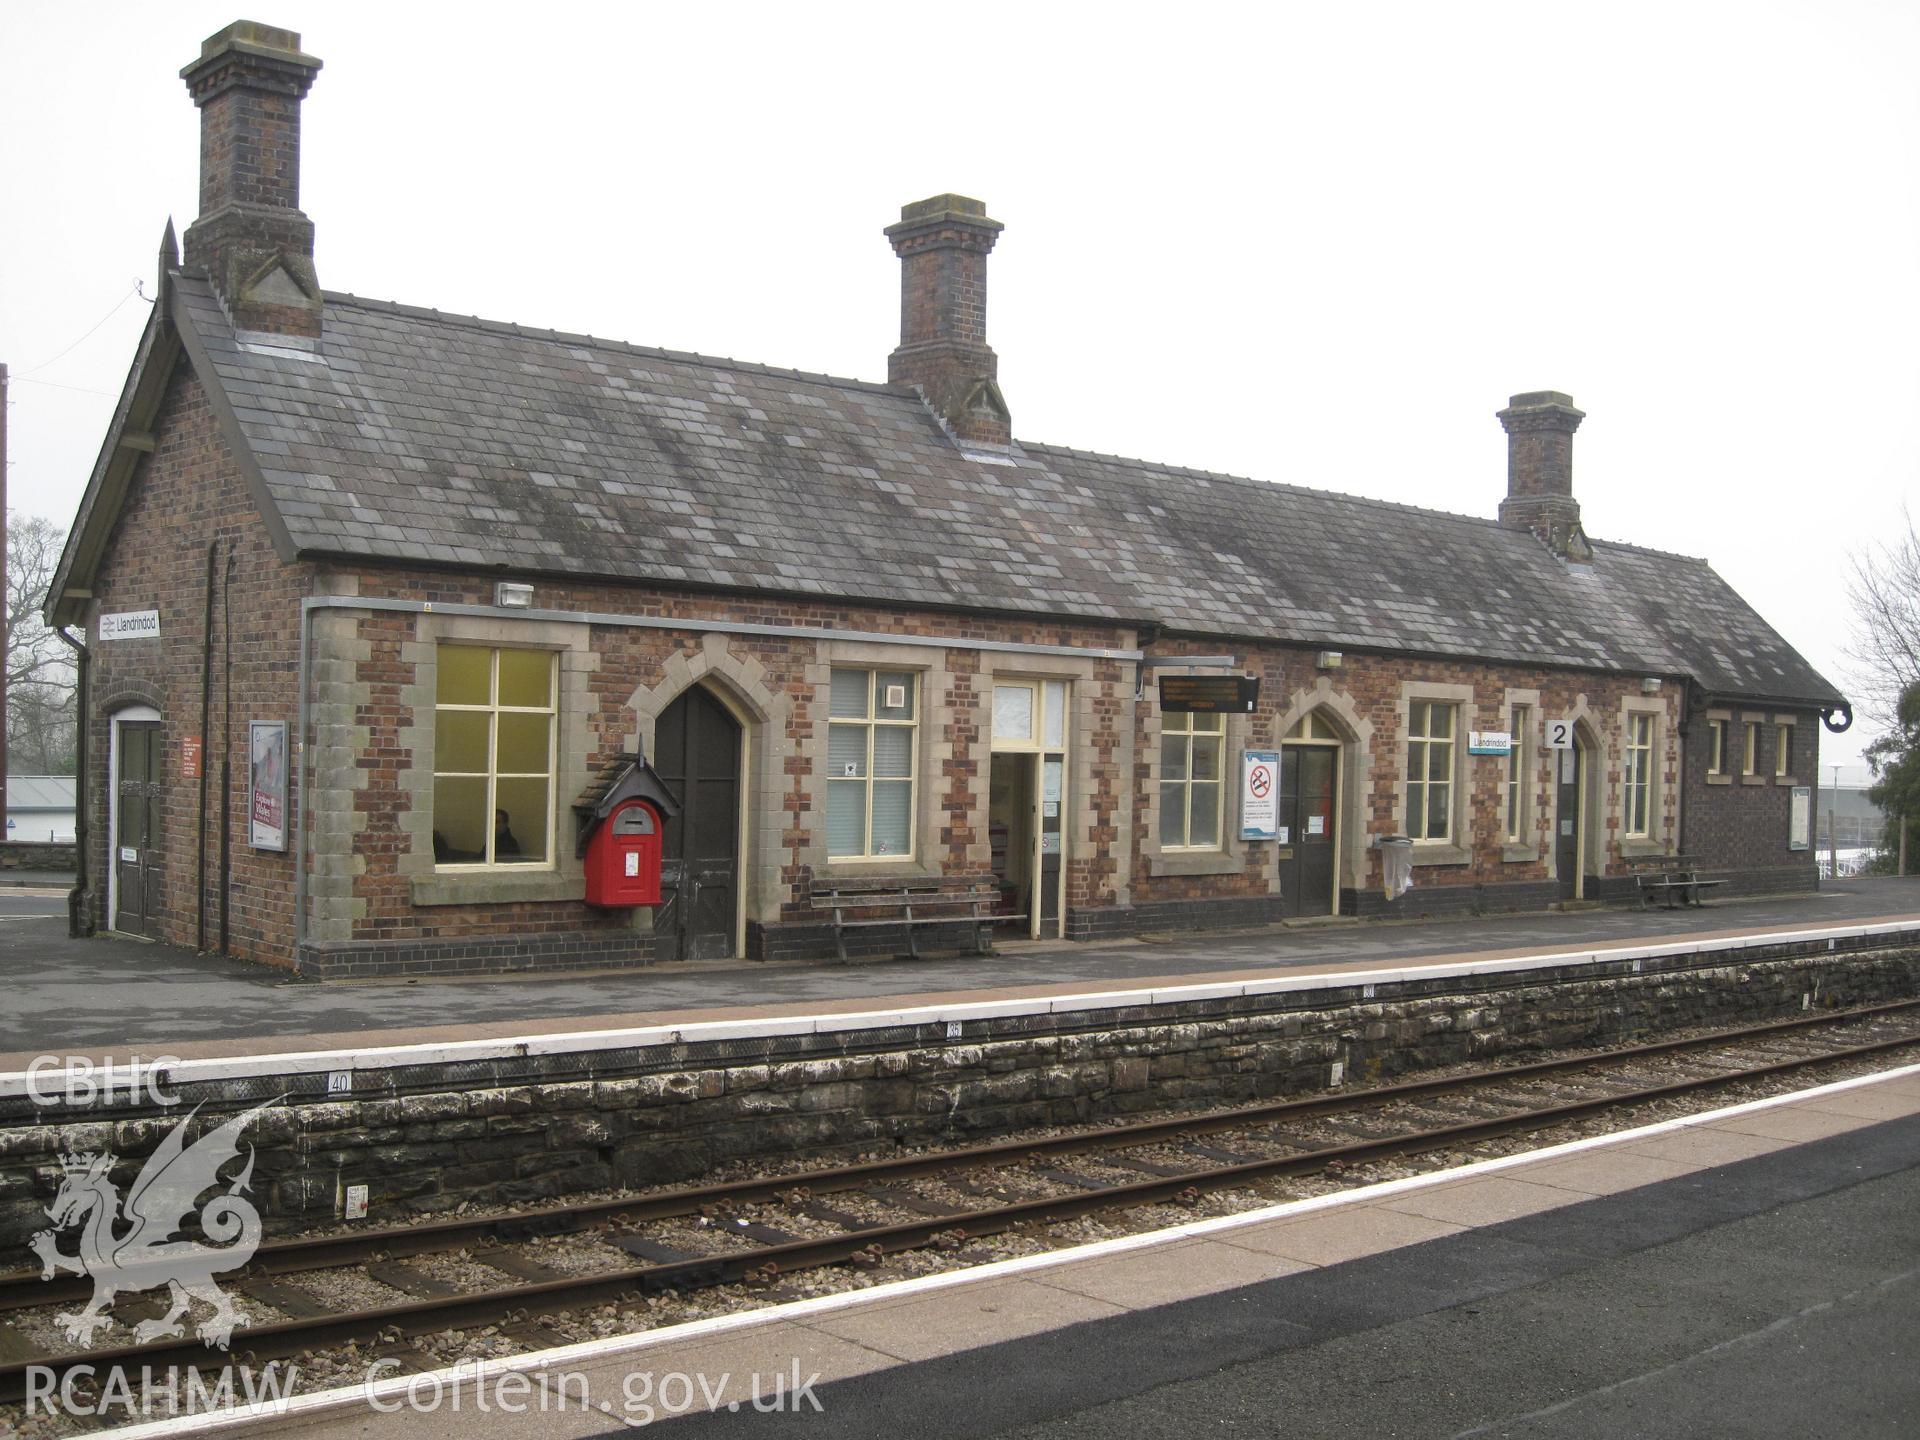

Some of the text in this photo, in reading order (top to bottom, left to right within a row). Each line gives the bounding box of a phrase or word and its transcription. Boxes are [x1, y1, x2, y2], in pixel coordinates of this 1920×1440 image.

[116, 614, 156, 631] Llandrindod
[1474, 738, 1507, 748] Llandrindod
[1553, 725, 1566, 744] 2
[333, 1075, 348, 1092] 40
